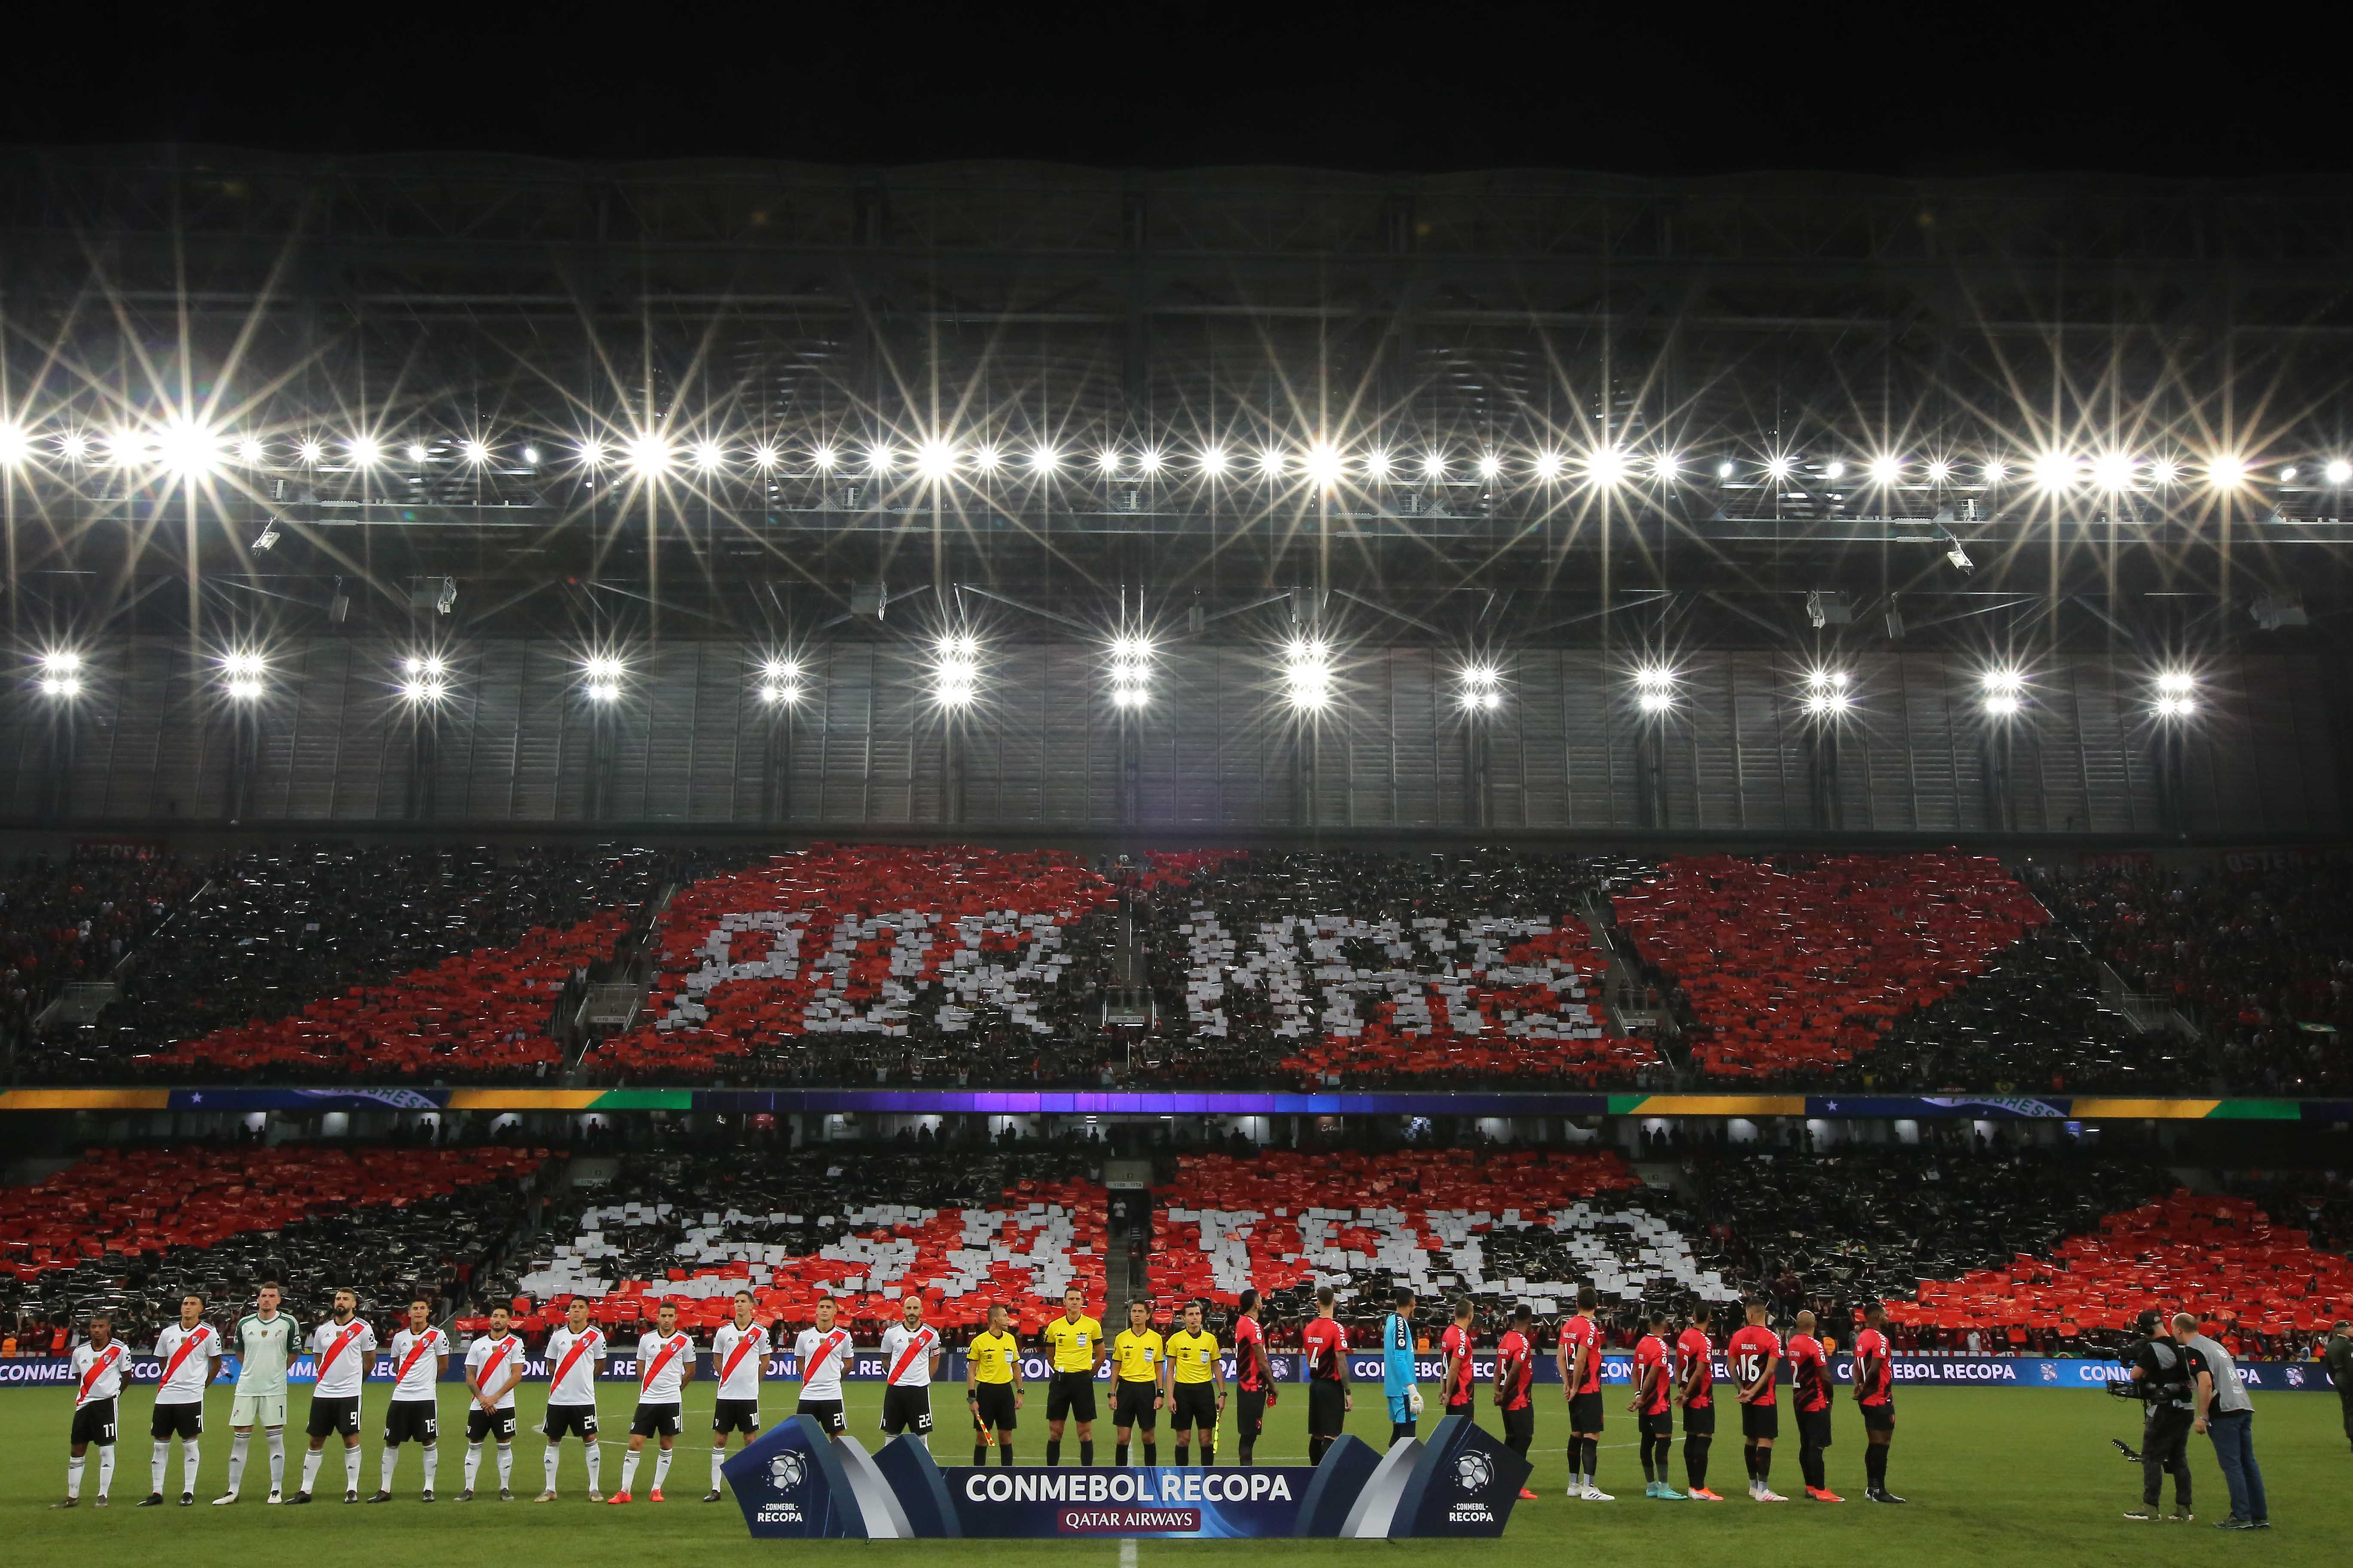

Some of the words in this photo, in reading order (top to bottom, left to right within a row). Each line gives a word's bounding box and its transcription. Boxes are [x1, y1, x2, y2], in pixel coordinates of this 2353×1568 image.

[1310, 1346, 1319, 1370] 4
[0, 1365, 76, 1381] CONME
[131, 1364, 161, 1379] ECO
[370, 1364, 396, 1377] REC
[1354, 1361, 1442, 1377] COEBO
[1500, 1358, 1507, 1386] 5
[1740, 1353, 1760, 1382] 16
[1791, 1360, 1801, 1388] 2
[1837, 1364, 1941, 1380] COEBOL
[1944, 1364, 2017, 1380] RECOPA
[2079, 1365, 2132, 1382] CONM
[279, 1405, 283, 1418] 1
[350, 1412, 357, 1425] 9
[195, 1414, 201, 1428] 7
[425, 1419, 435, 1433] 15
[504, 1419, 515, 1433] 20
[584, 1415, 596, 1429] 24
[749, 1413, 758, 1426] 10
[834, 1412, 843, 1427] 21
[919, 1414, 931, 1428] 22
[103, 1423, 115, 1438] 11
[965, 1474, 1154, 1502] CONMEBOL
[1162, 1474, 1292, 1502] RECOPA
[757, 1511, 803, 1522] RECOPA
[1065, 1511, 1121, 1527] QATAR
[1124, 1511, 1193, 1527] AIRWAYS
[1449, 1511, 1494, 1522] RECOPA
